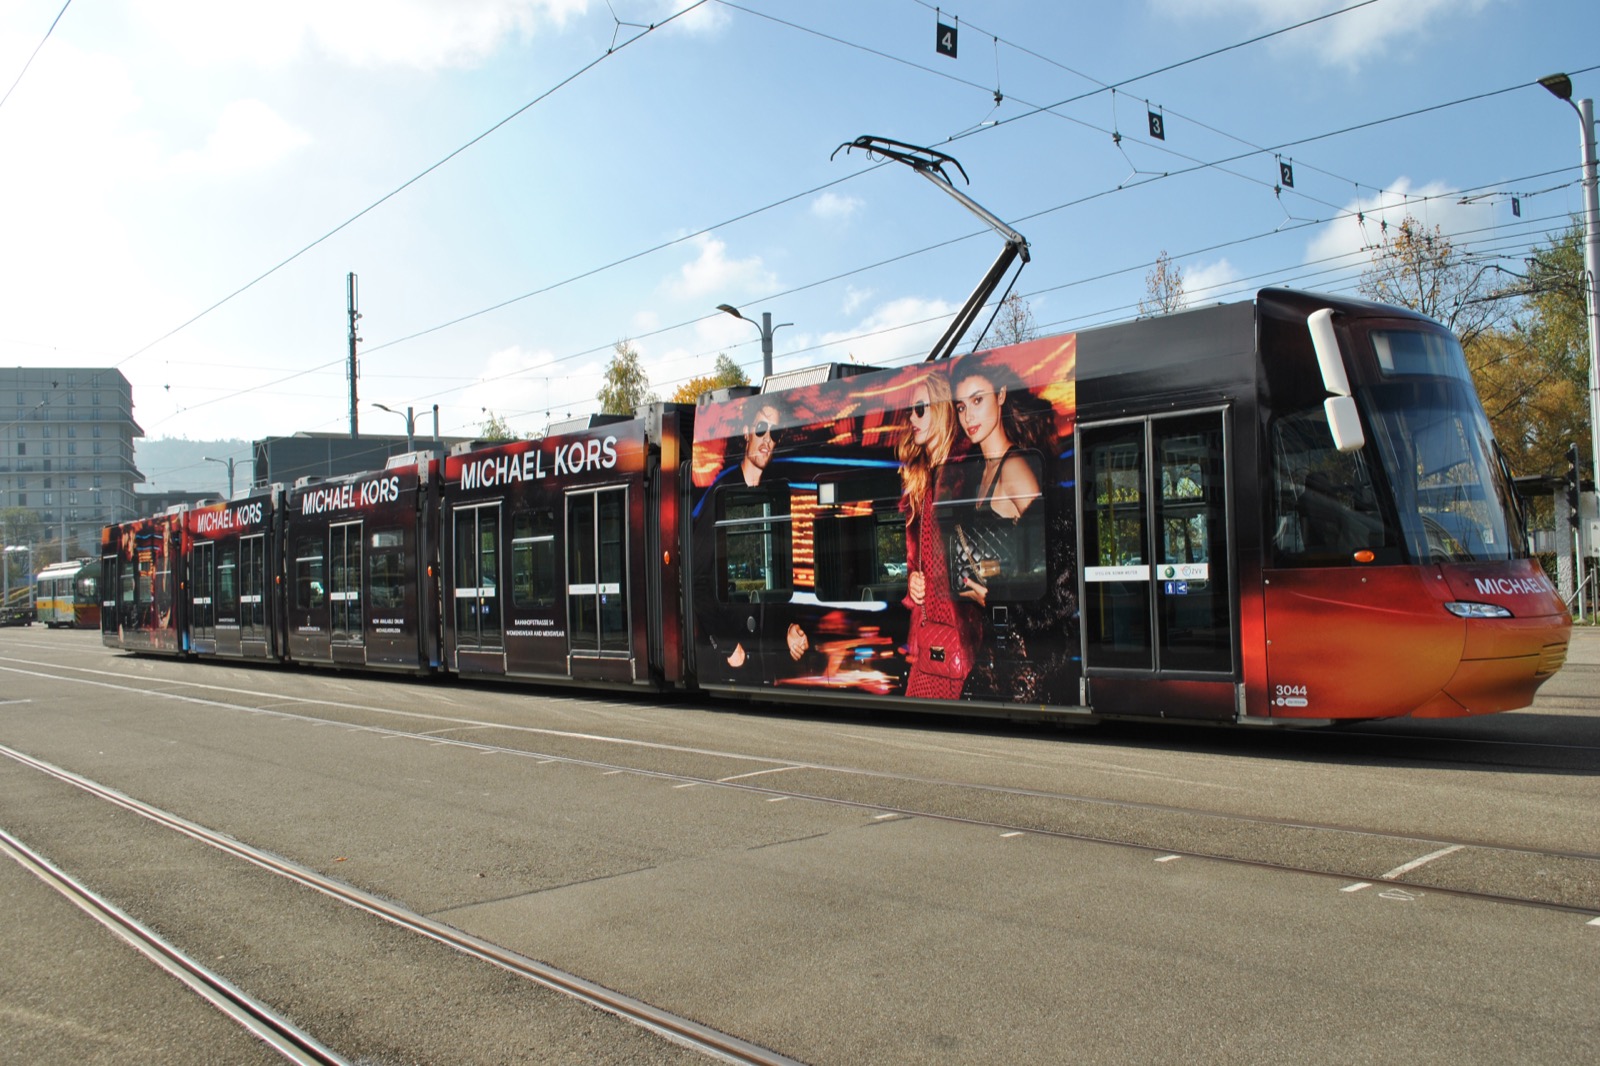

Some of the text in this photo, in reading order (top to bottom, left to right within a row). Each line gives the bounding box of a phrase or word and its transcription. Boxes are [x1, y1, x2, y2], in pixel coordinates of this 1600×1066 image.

[941, 31, 953, 51] 4
[1152, 117, 1161, 134] 3
[1283, 167, 1291, 183] 2
[461, 435, 618, 491] MICHAEL KORS
[302, 475, 400, 516] MICHAEL KORS
[197, 502, 263, 533] MICHAEL KORS
[1474, 577, 1547, 595] MICHAEL
[1276, 684, 1308, 696] 3044
